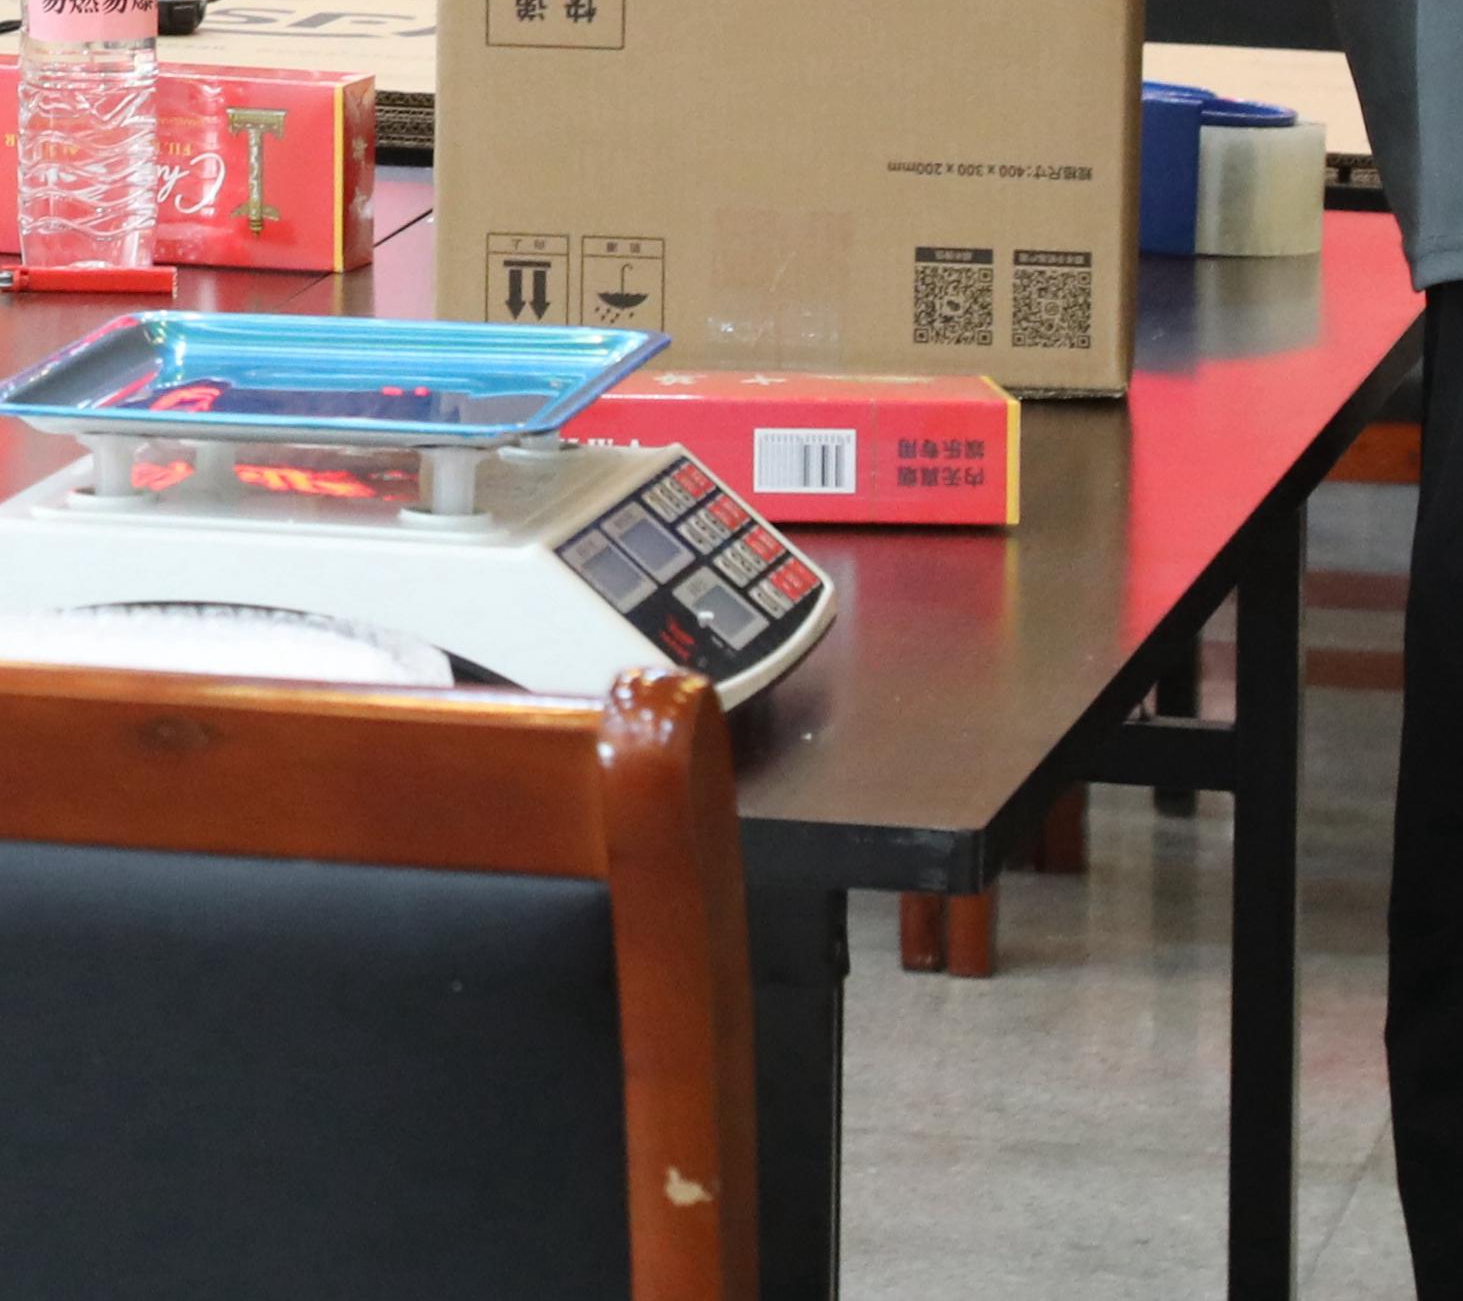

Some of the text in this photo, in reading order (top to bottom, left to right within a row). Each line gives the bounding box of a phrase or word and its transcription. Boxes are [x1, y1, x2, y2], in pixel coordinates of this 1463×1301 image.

[887, 161, 943, 176] 200mm
[958, 164, 983, 177] 300
[897, 438, 985, 459] 娱乐专用
[897, 466, 985, 487] 内无真烟
